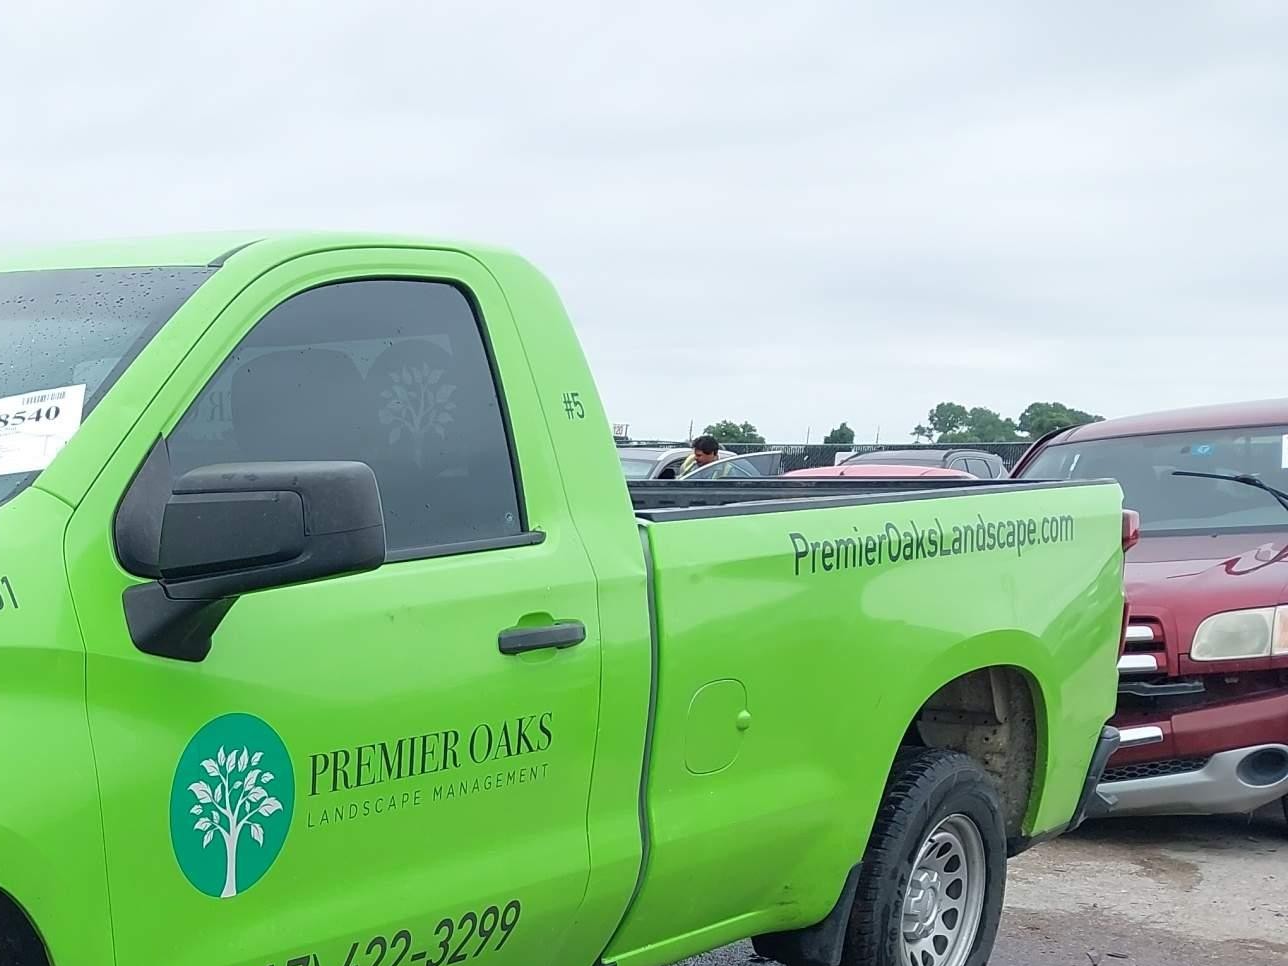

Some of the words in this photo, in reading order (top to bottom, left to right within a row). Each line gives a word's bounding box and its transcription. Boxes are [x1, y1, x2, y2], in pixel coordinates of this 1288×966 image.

[563, 392, 585, 420] #5
[789, 514, 1074, 576] PremierOaksLandscape.com
[307, 729, 461, 797] PREMIER
[469, 711, 554, 764] OAKS
[306, 790, 422, 828] LANDSCAPE
[432, 763, 551, 801] MANAGEMENT
